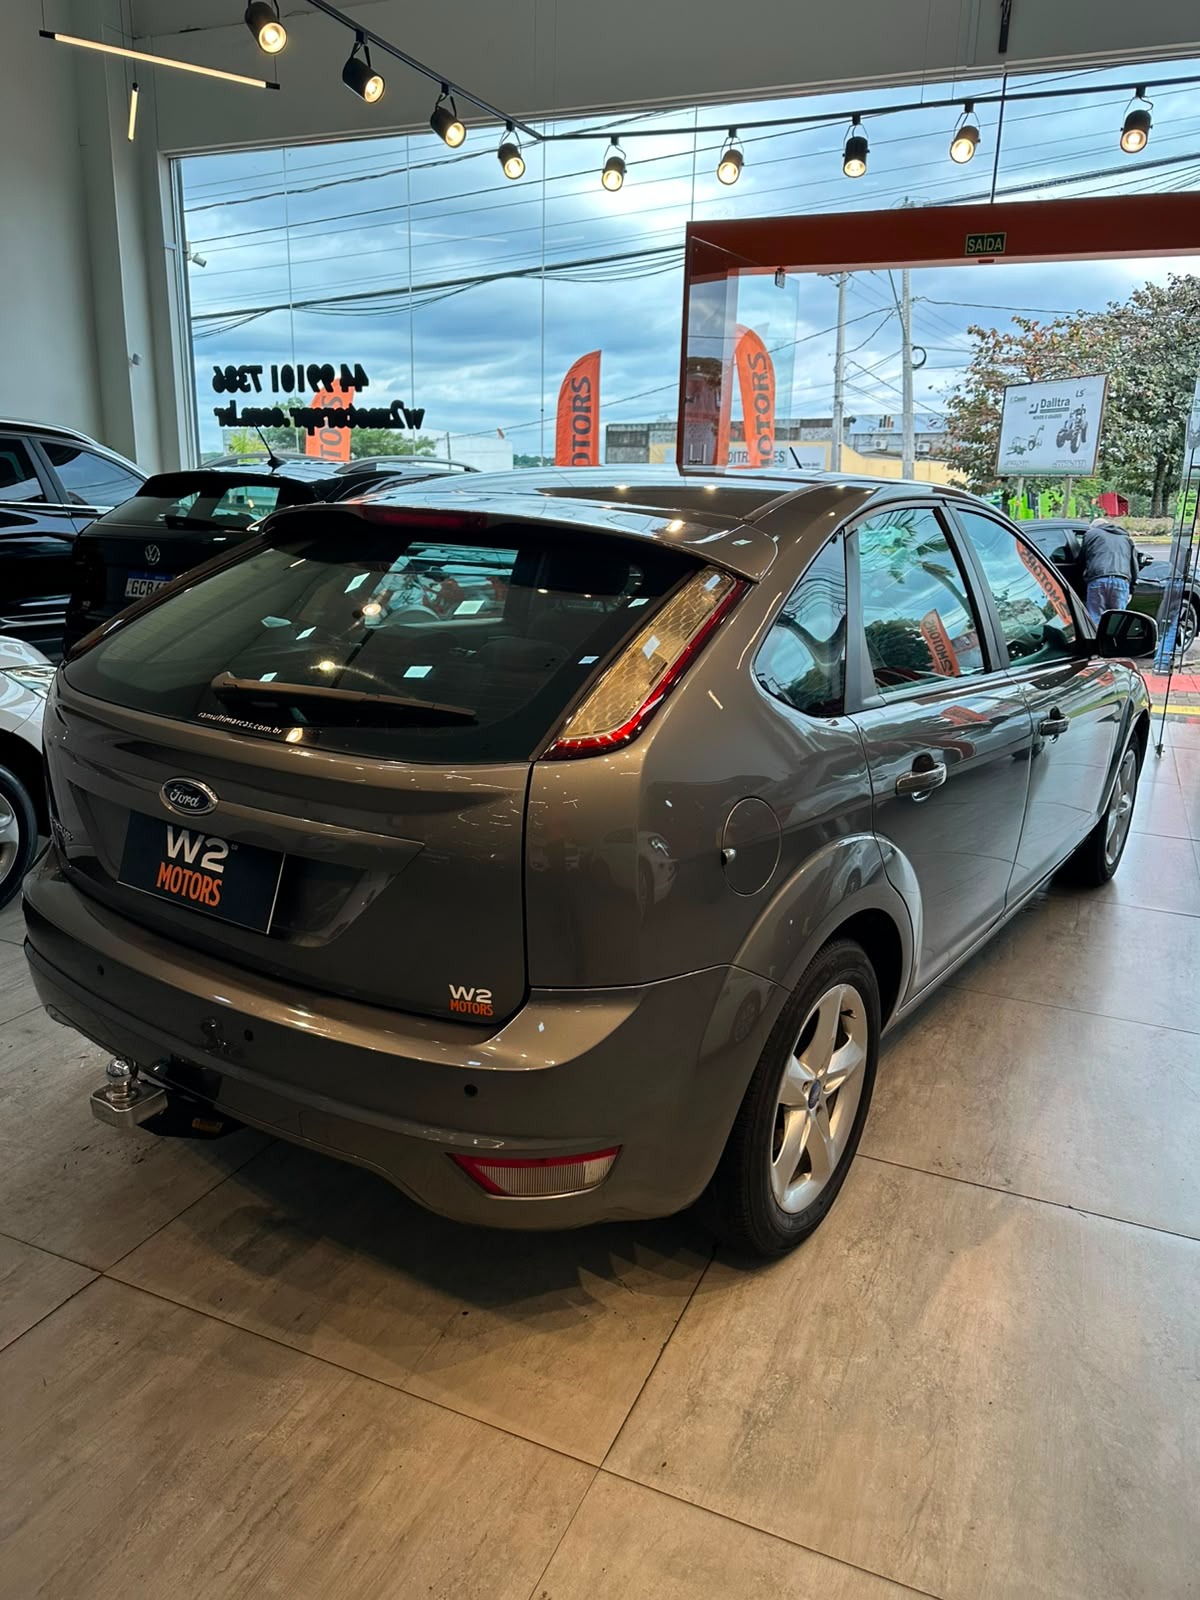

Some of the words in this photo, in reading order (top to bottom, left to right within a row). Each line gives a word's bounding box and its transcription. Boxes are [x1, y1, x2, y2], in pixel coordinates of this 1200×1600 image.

[968, 235, 1003, 252] SAÍDA
[198, 711, 282, 734] ramultimarcas.com.br
[169, 784, 201, 808] Ford
[166, 824, 230, 874] W2
[156, 861, 223, 907] MOTORS
[448, 984, 492, 1004] W2
[449, 999, 494, 1016] MOTORS
